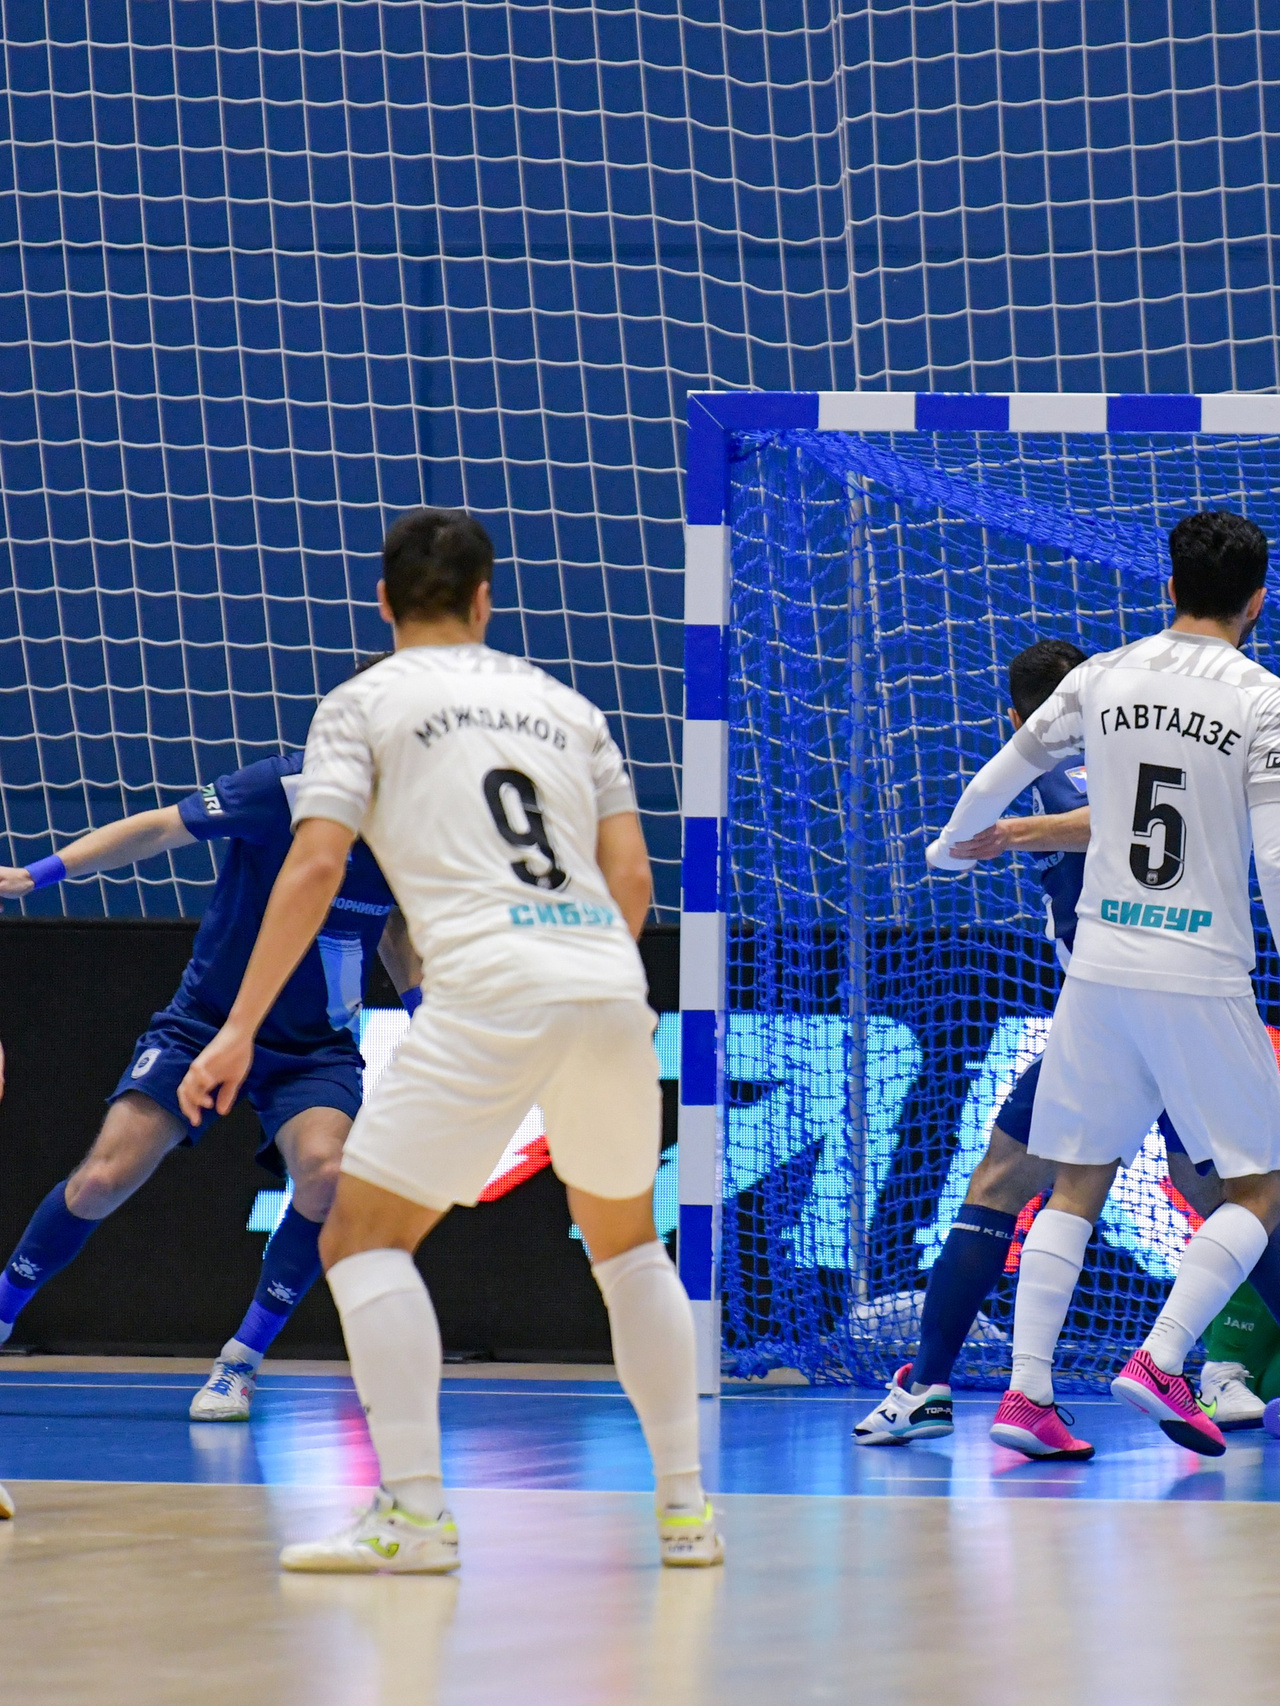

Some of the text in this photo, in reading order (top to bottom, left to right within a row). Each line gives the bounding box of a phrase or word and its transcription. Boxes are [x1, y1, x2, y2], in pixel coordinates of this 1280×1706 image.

[1100, 703, 1242, 756] ГАВТАДЗЕ
[202, 783, 223, 814] ARI
[483, 768, 571, 891] 9
[1129, 762, 1187, 890] 5
[1101, 899, 1213, 933] СИБУР
[983, 1227, 1014, 1240] KEL
